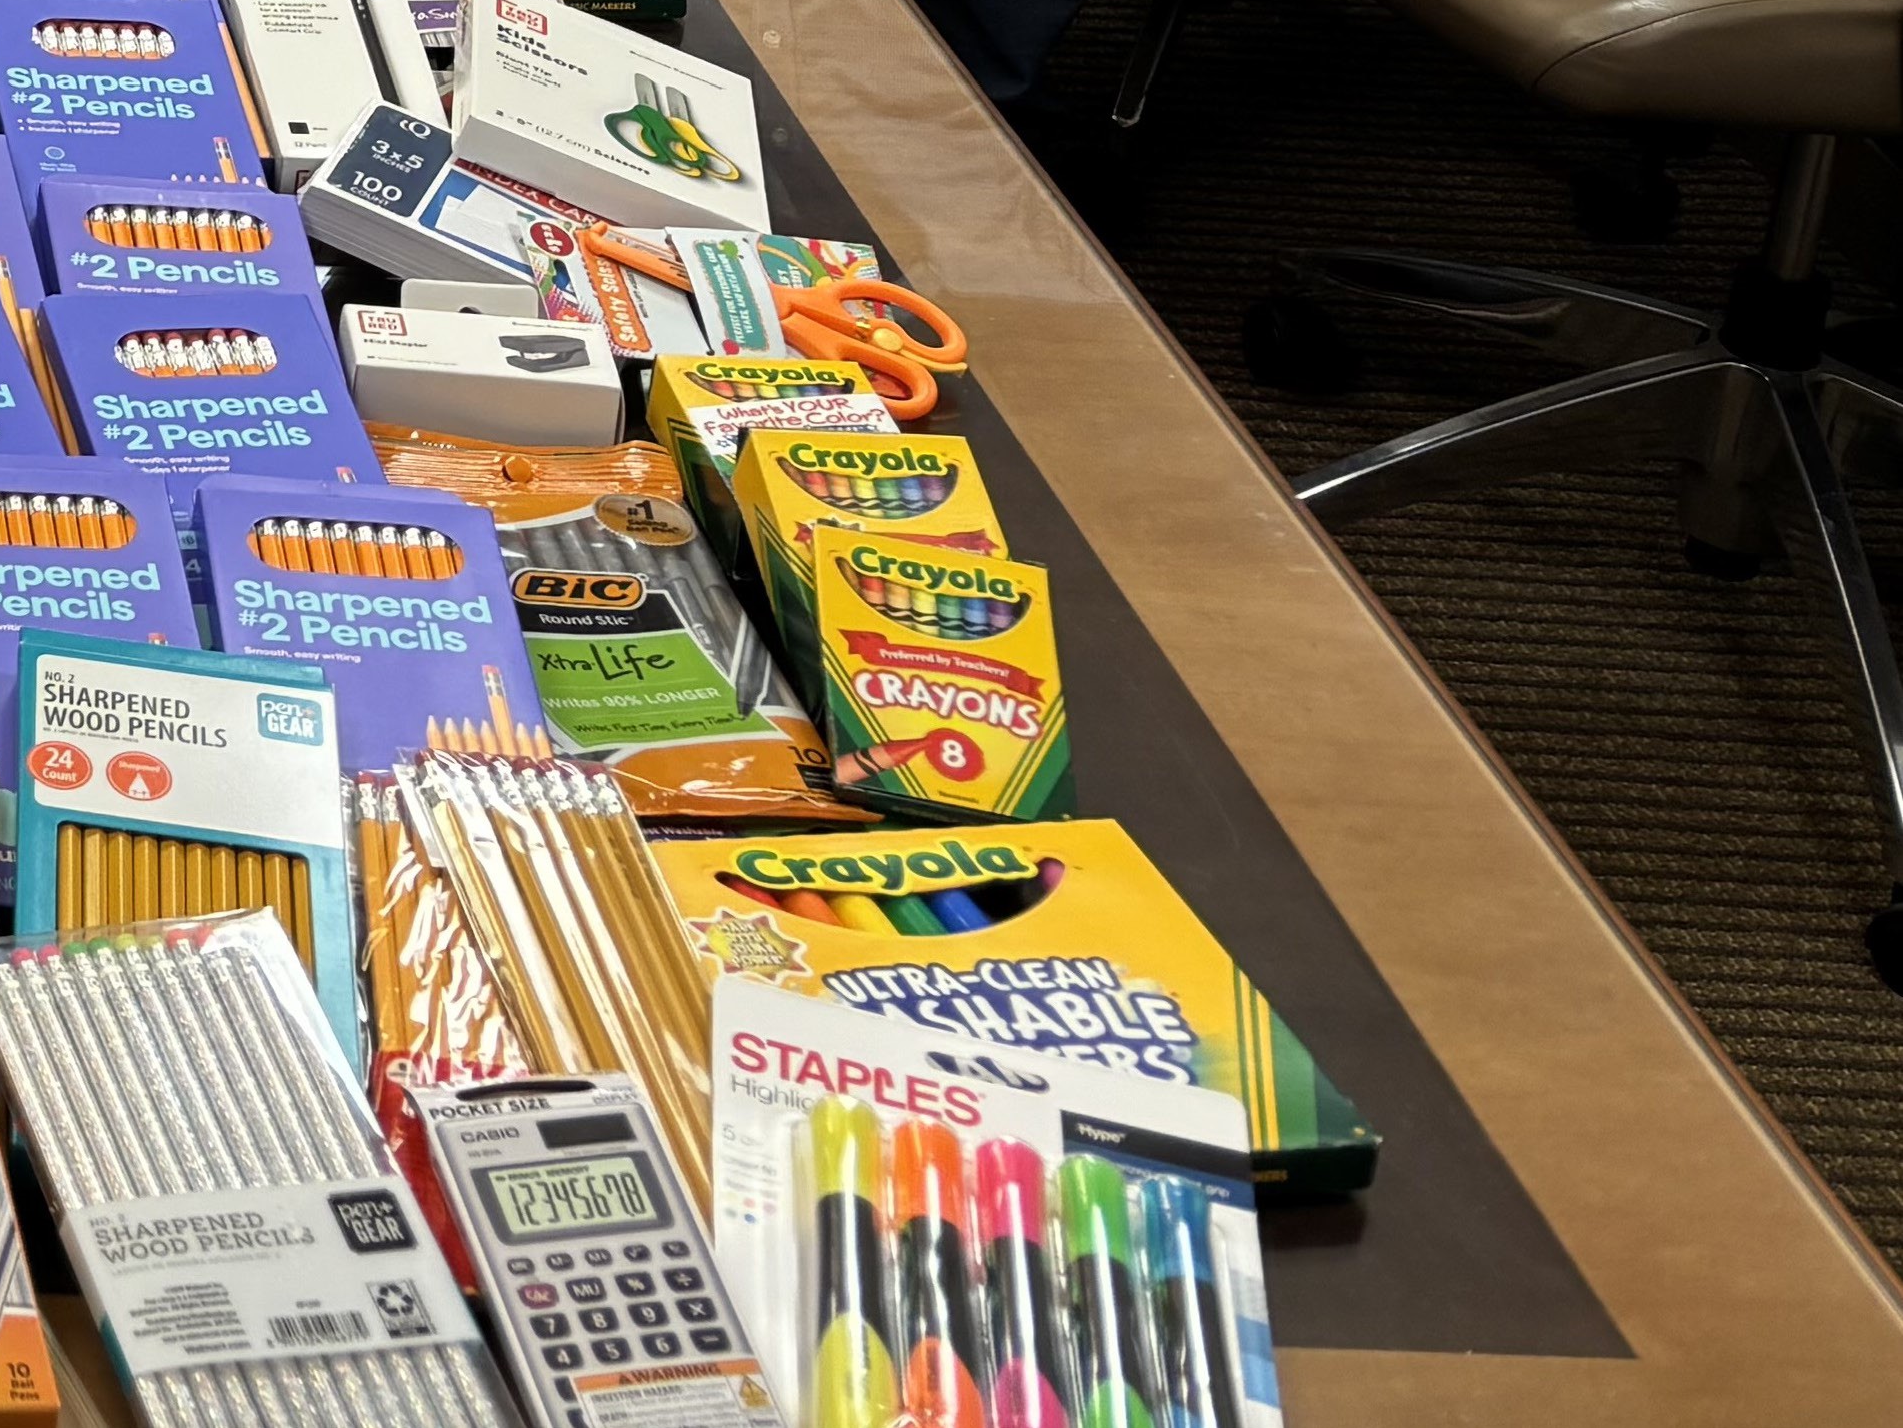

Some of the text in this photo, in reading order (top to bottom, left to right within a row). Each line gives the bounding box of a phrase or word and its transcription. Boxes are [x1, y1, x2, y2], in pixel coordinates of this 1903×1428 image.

[6, 67, 216, 96] Sharpened
[13, 91, 196, 120] #2 Pencils
[354, 171, 402, 201] 100
[696, 363, 841, 384] Crayola
[719, 397, 851, 421] What's YOUR
[806, 408, 885, 426] Color?
[789, 443, 943, 474] Crayola
[850, 546, 1015, 598] Crayola
[234, 580, 492, 625] Sharpened
[238, 610, 465, 652] #2 Pencils
[595, 613, 629, 627] Stic
[44, 683, 191, 720] SHARPENED
[854, 671, 1042, 738] CRAYONS
[43, 708, 227, 748] WOOD PENCILS
[267, 712, 314, 739] GEAR
[47, 748, 73, 768] 24
[942, 738, 967, 768] 8
[42, 766, 78, 781] Count
[736, 839, 1028, 892] Crayola
[826, 958, 1118, 1003] ULTRA-CLEAN
[730, 1031, 980, 1127] STAPLES
[502, 1095, 551, 1113] SIZE
